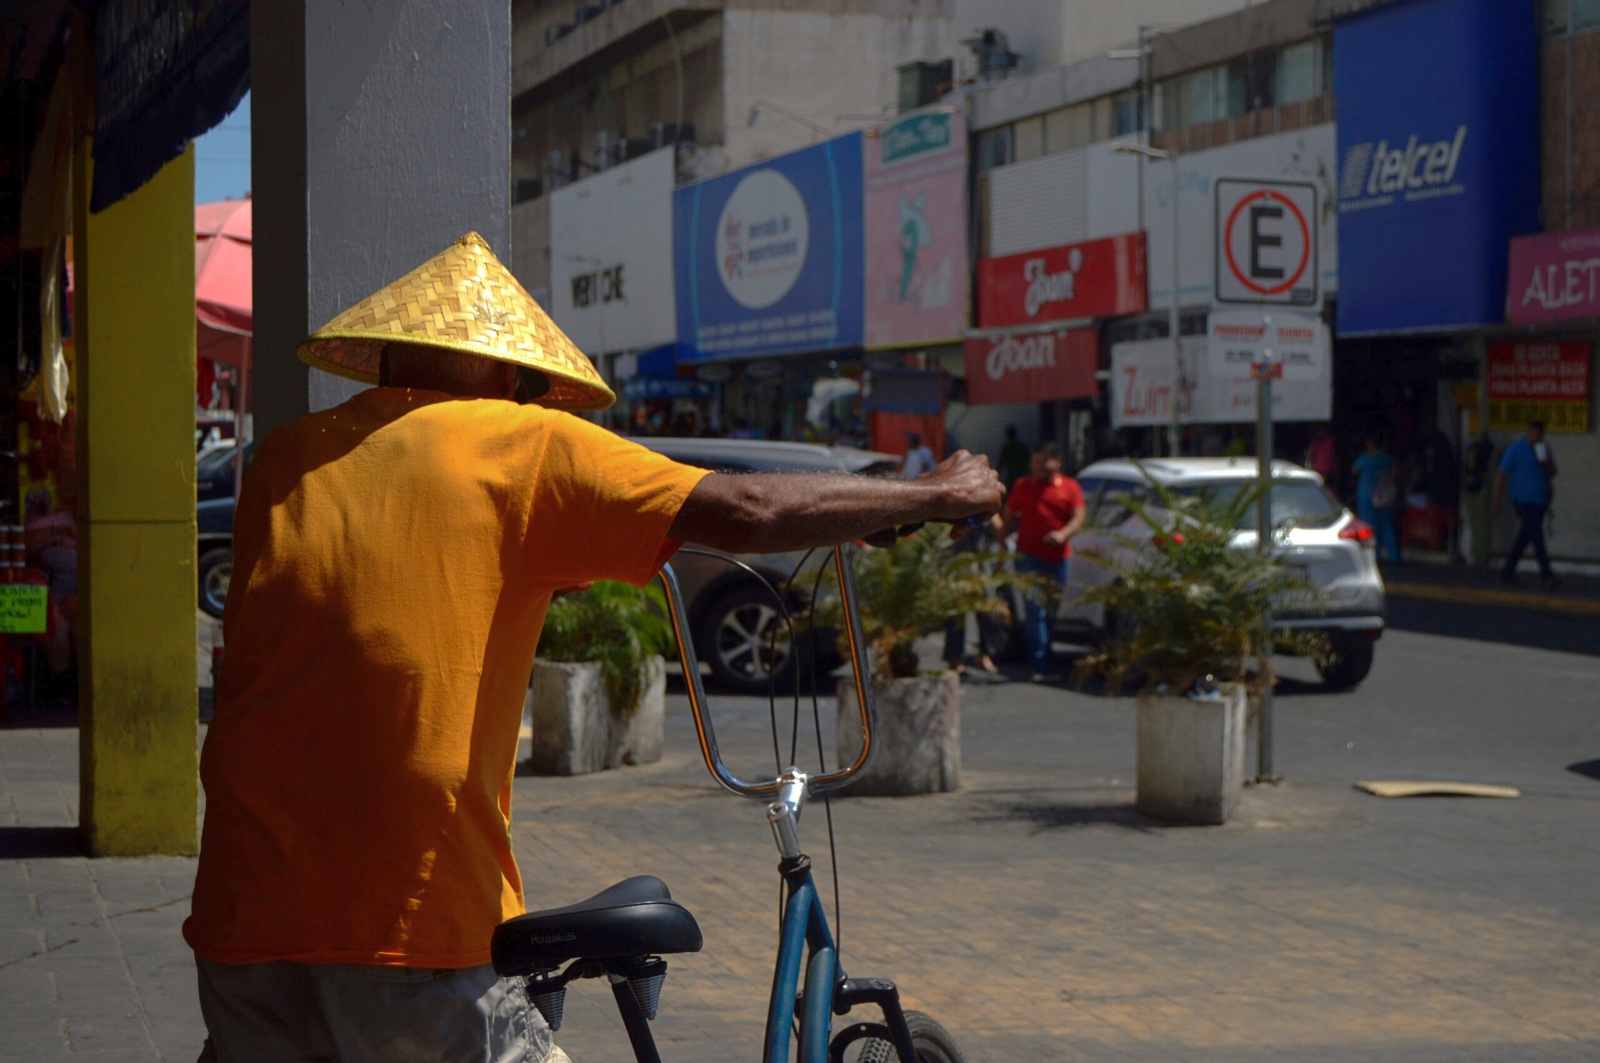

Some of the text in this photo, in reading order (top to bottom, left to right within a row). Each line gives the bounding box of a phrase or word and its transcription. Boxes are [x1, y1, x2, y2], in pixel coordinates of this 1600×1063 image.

[1367, 125, 1467, 195] telcel
[1251, 206, 1284, 279] E
[1521, 257, 1600, 309] ALET
